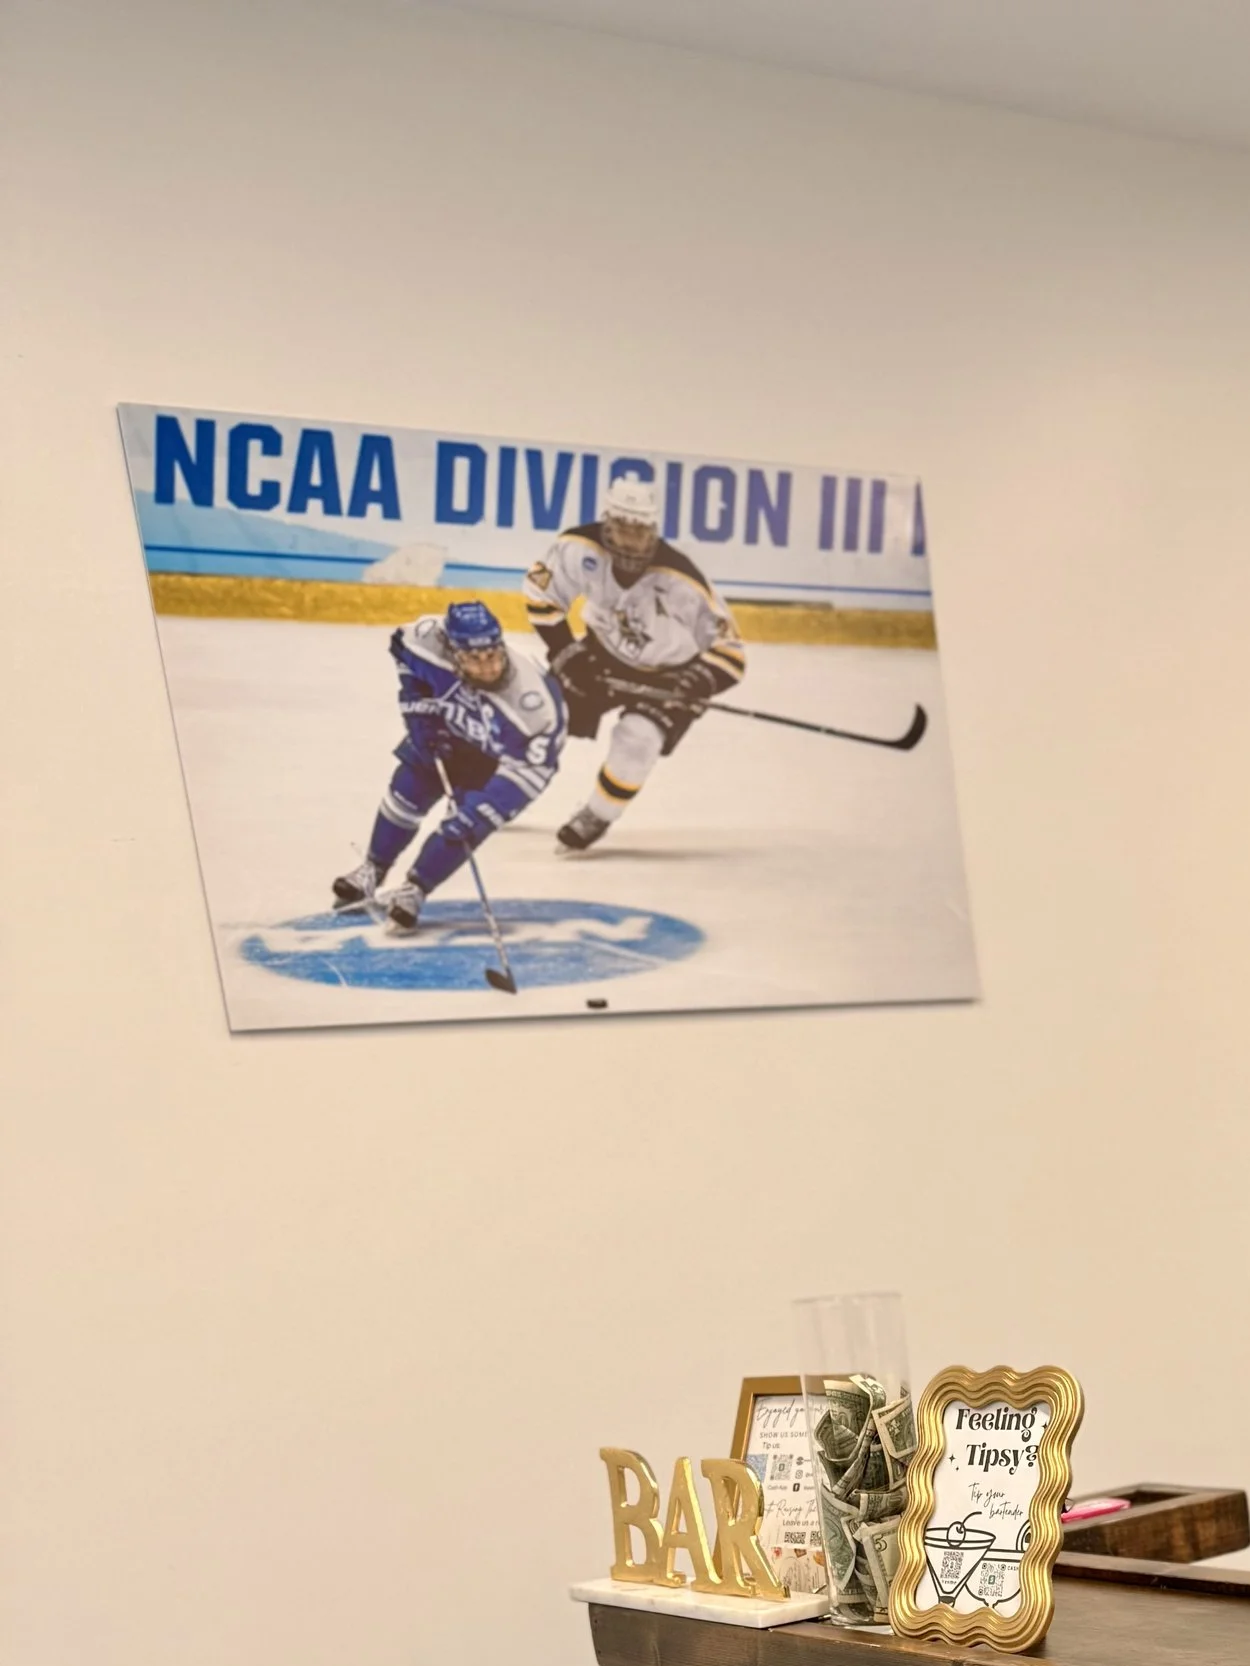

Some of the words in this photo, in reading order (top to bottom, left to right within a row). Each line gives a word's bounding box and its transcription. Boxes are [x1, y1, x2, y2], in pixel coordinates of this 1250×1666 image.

[154, 413, 402, 521] NCAA
[955, 1406, 1038, 1443] Feeling
[966, 1442, 1039, 1475] Tipsy?
[599, 1447, 791, 1602] BAR
[989, 1500, 1024, 1521] bartender
